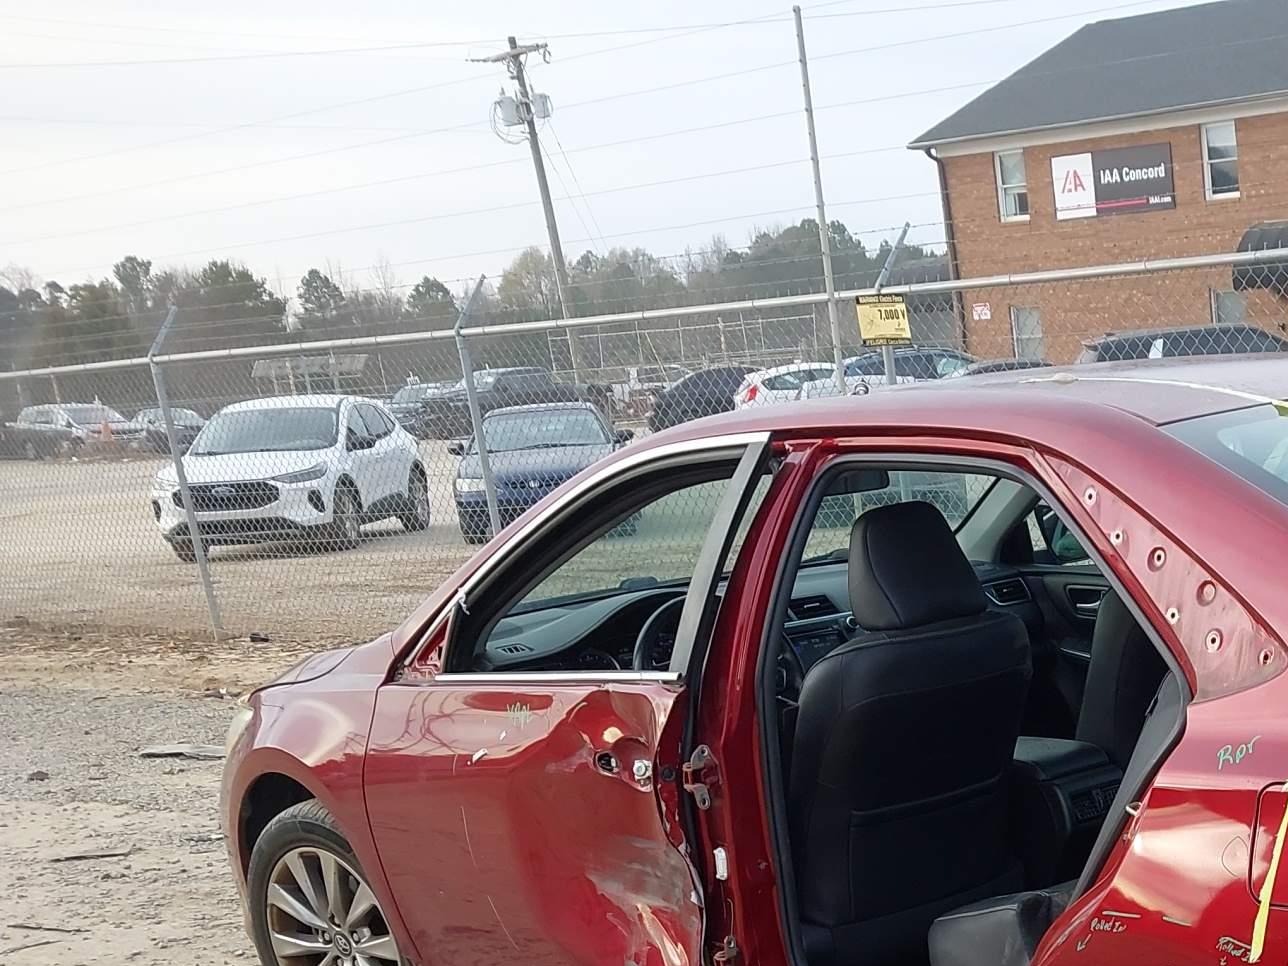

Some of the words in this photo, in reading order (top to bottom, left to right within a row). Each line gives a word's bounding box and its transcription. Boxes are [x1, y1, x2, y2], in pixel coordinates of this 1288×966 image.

[1100, 168, 1121, 184] IAA
[1122, 162, 1166, 182] Concord
[877, 309, 899, 321] 7,000
